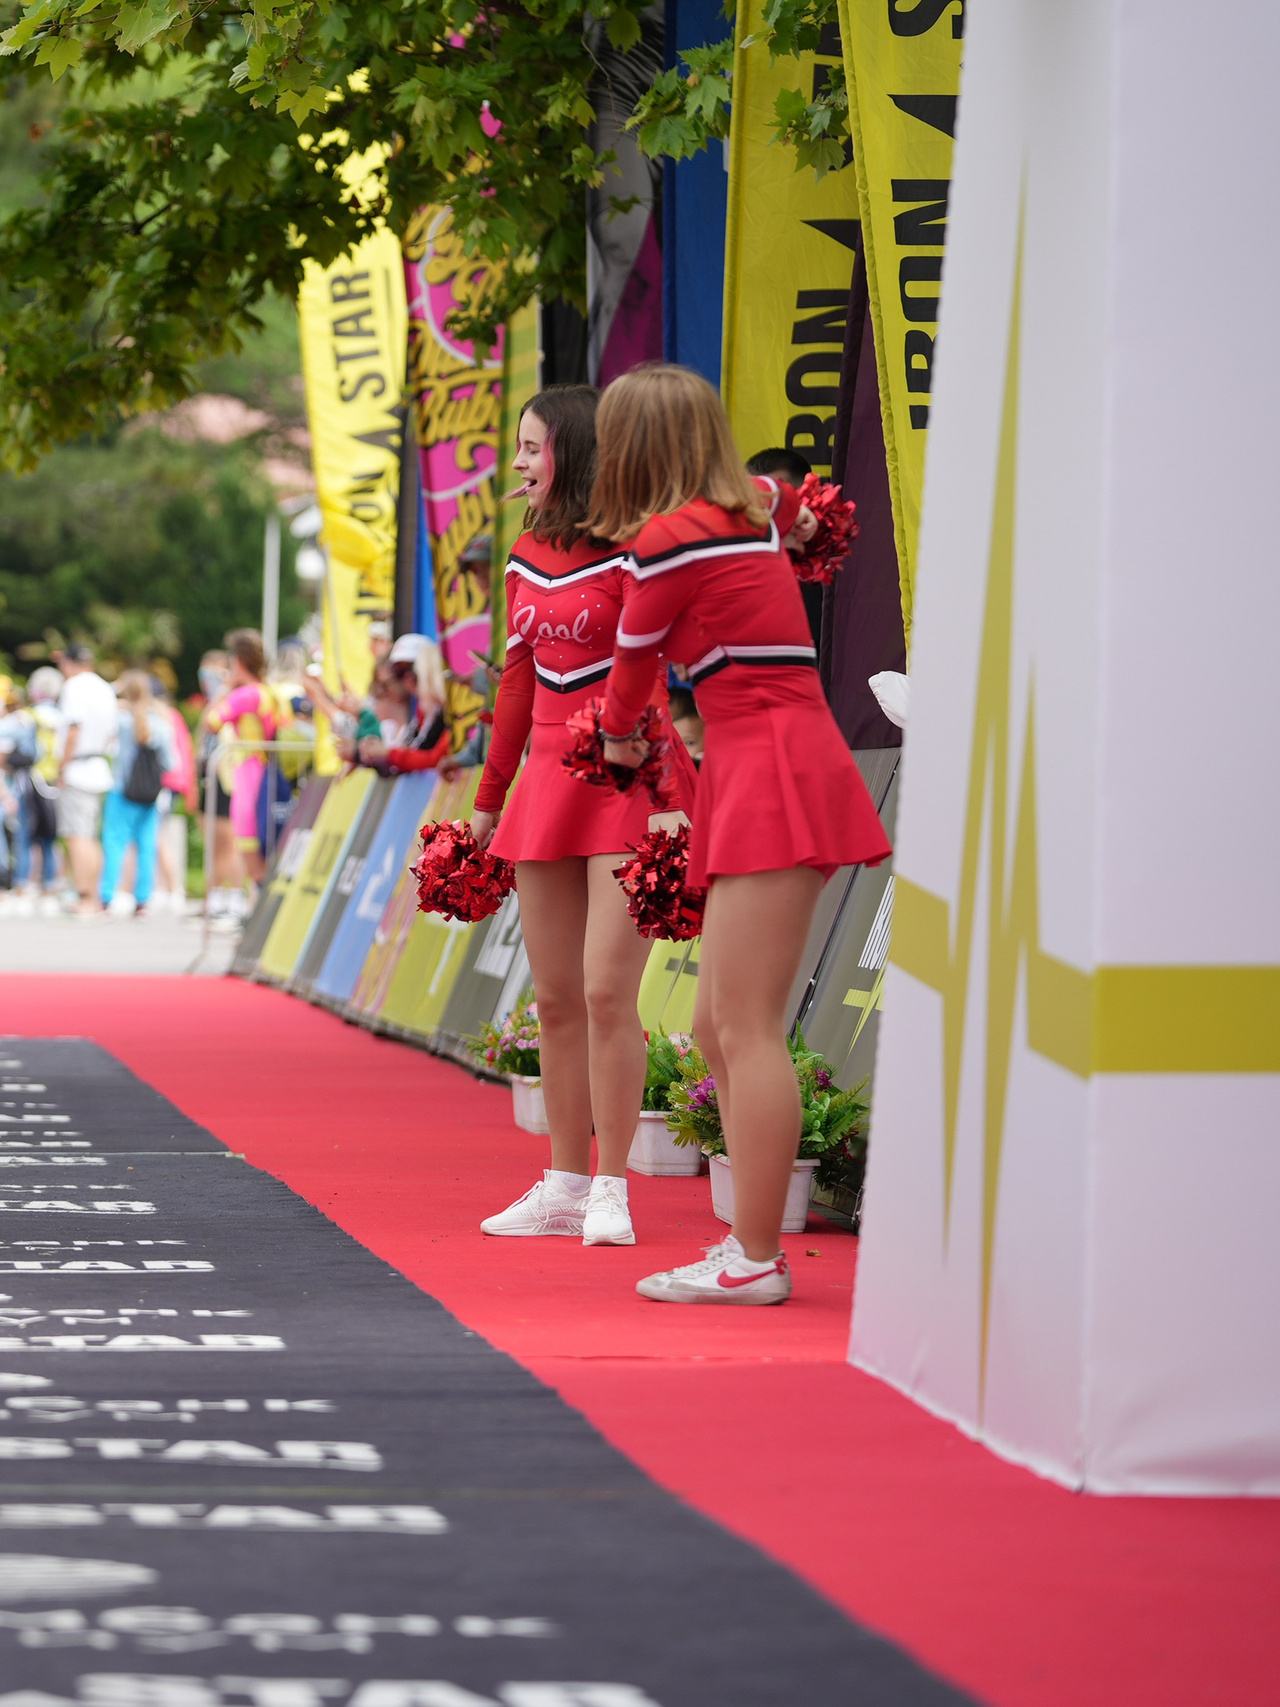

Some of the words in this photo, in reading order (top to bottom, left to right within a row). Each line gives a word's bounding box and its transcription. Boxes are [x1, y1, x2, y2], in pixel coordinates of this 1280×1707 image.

[329, 270, 386, 403] STAR
[513, 604, 593, 648] Cool
[74, 1670, 664, 1707] STAR
